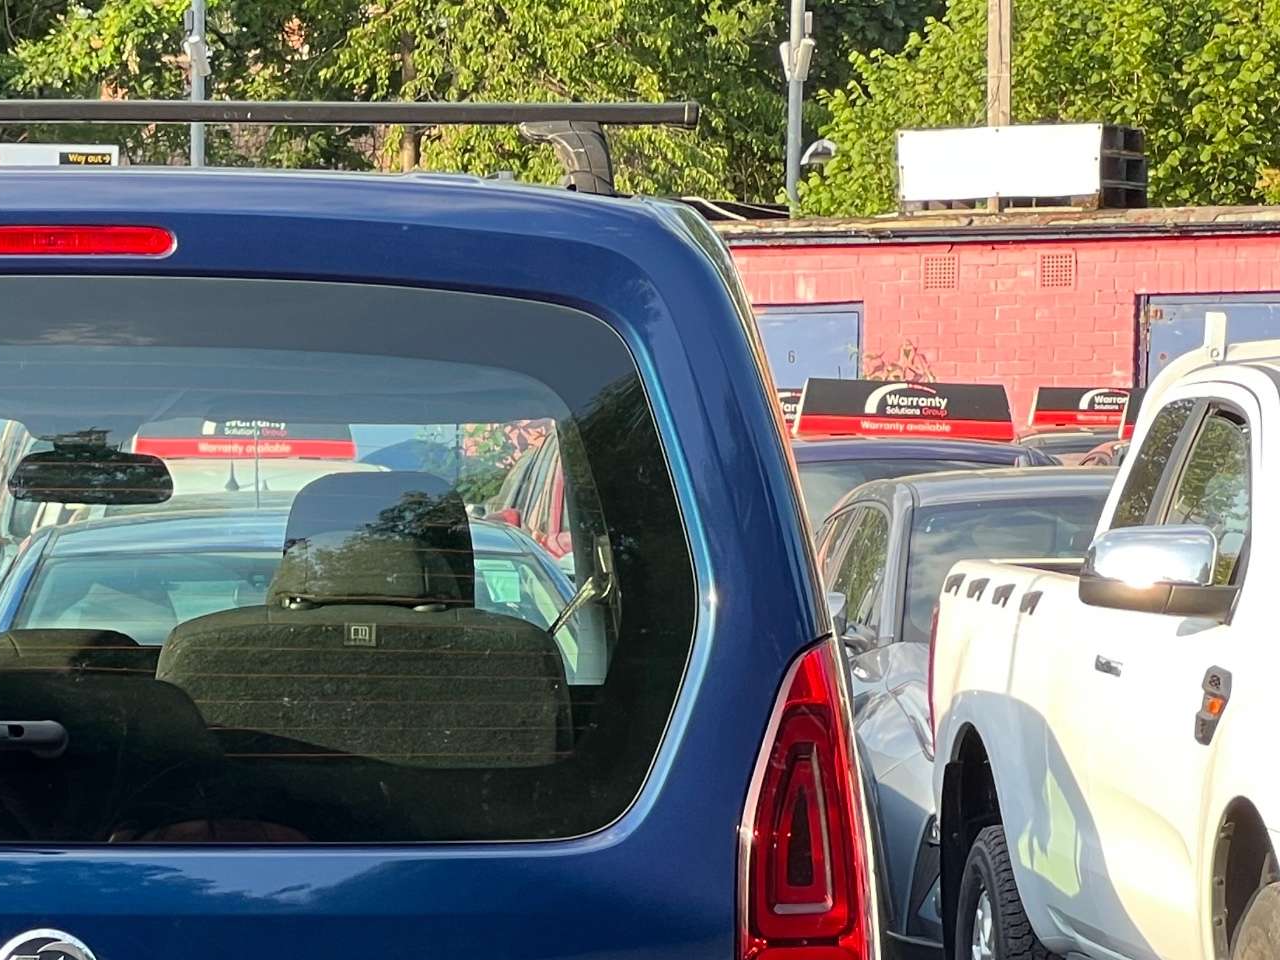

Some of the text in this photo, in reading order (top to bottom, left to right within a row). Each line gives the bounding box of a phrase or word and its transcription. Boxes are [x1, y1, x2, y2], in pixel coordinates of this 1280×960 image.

[68, 153, 102, 165] Way out
[788, 350, 795, 364] 6
[886, 394, 949, 409] Warranty
[886, 406, 948, 417] Solutions Group
[861, 420, 951, 432] Warranty available
[198, 443, 243, 454] Warranty
